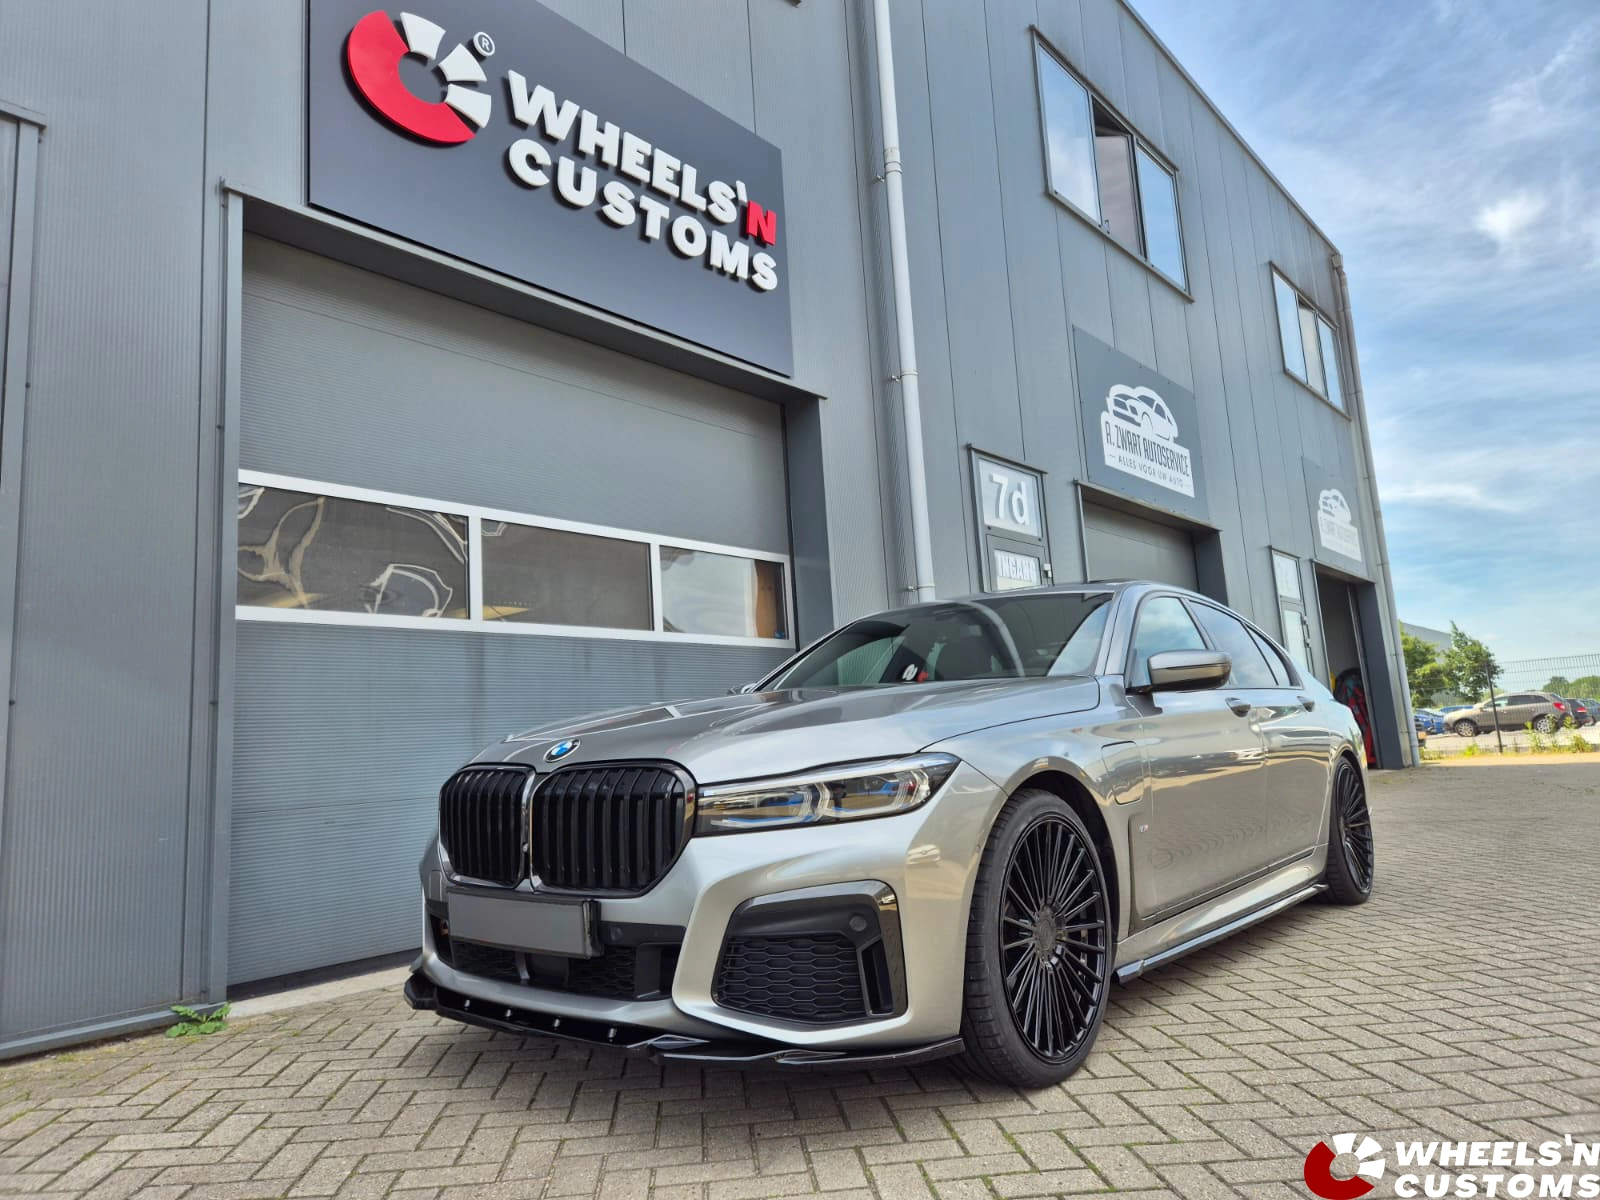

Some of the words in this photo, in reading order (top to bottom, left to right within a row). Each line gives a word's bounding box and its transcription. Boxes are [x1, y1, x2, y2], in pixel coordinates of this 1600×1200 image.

[508, 138, 778, 291] CUSTOMS
[1142, 437, 1190, 477] AUTOSERVICE
[991, 473, 1029, 525] 7d
